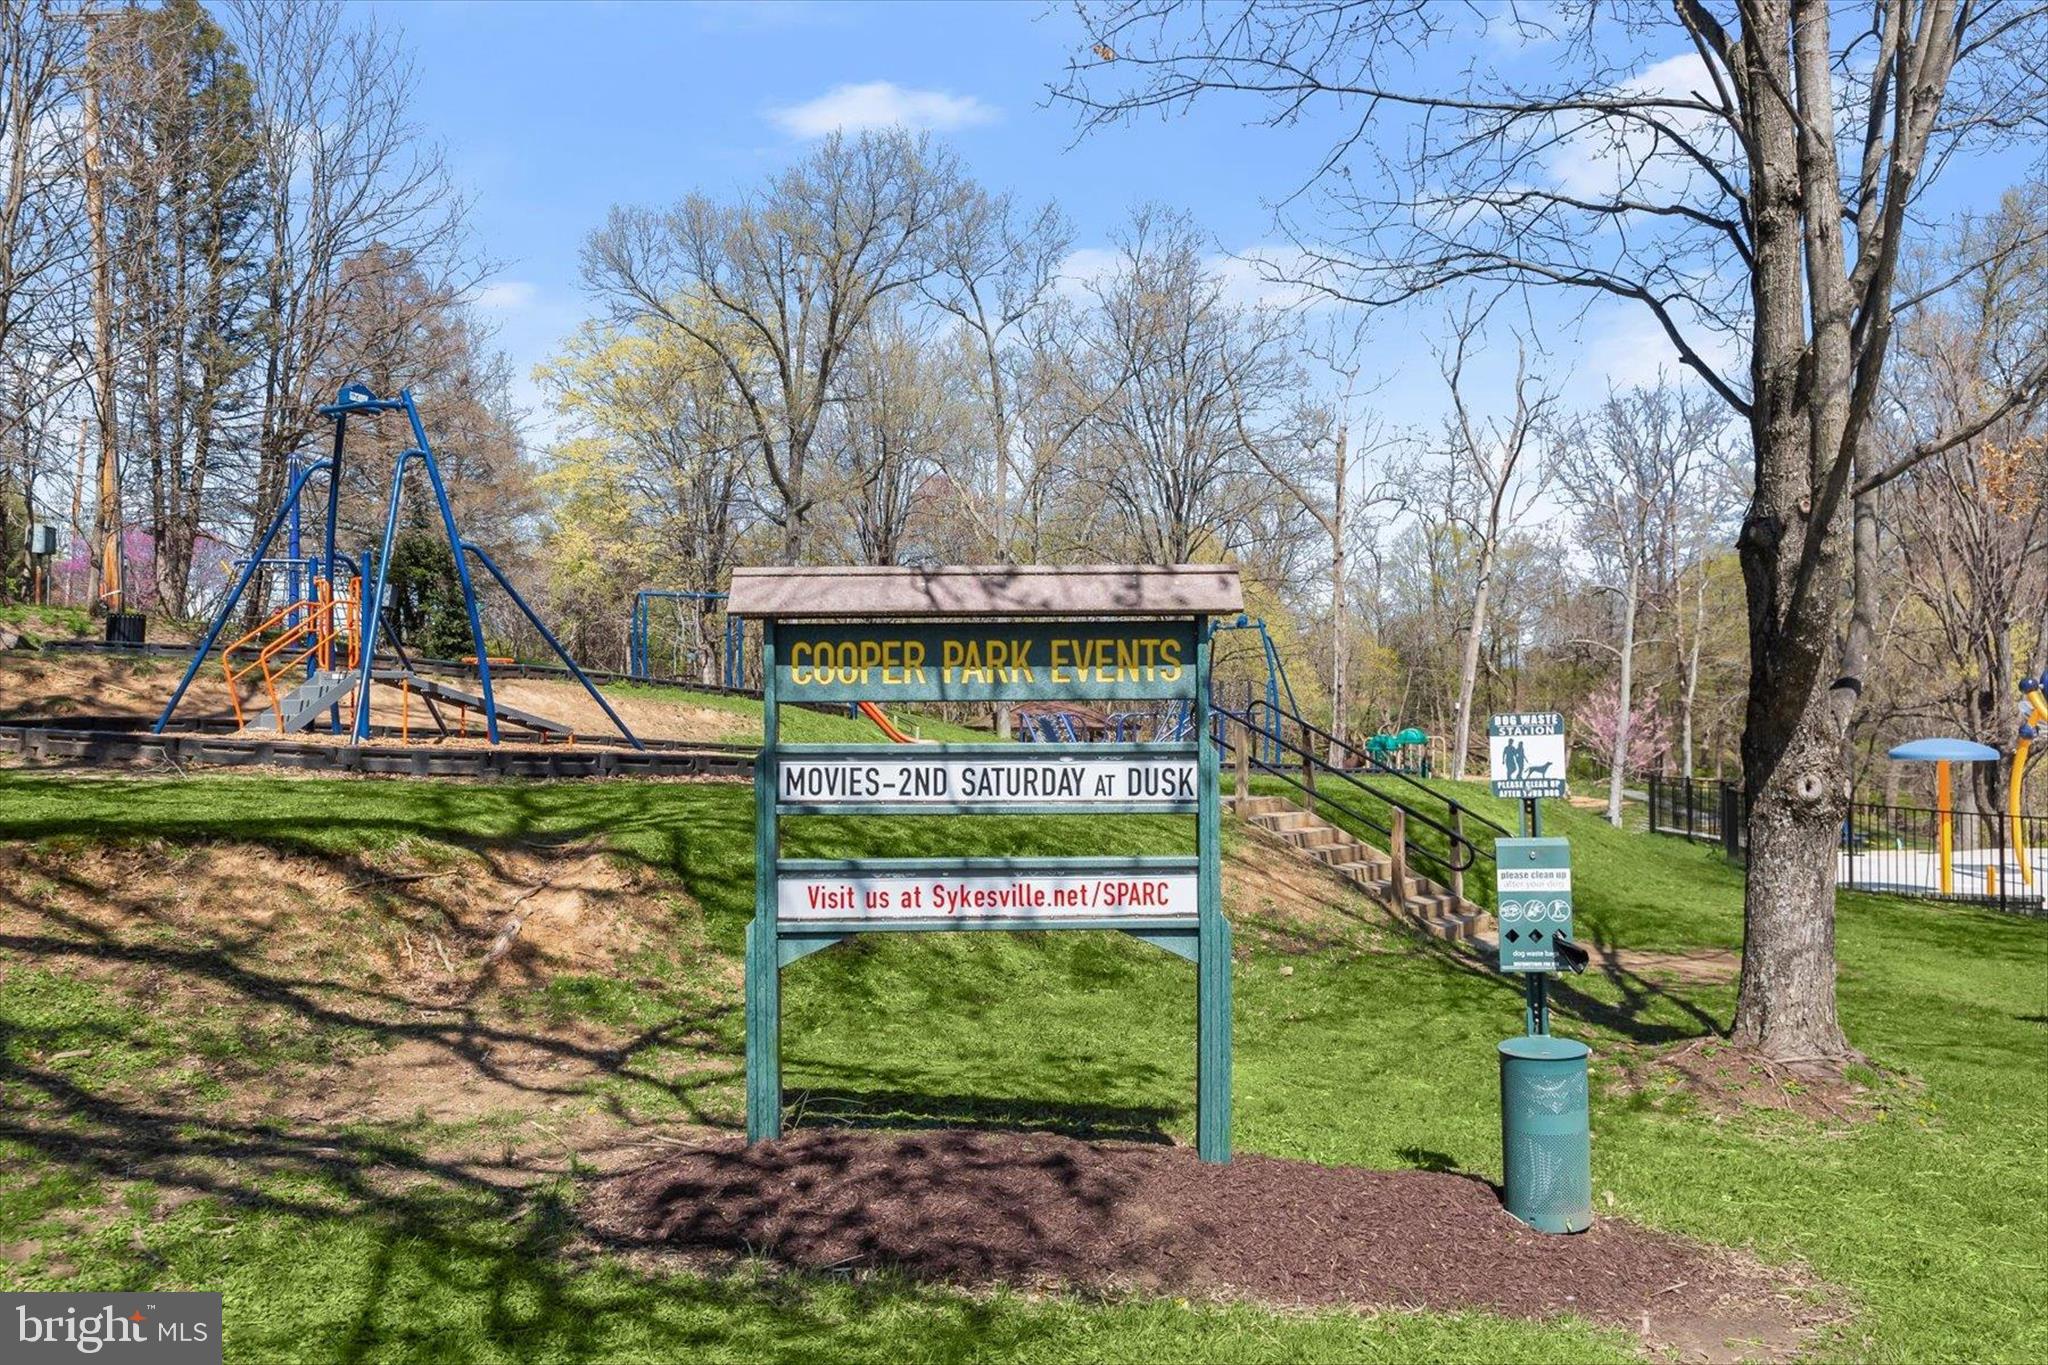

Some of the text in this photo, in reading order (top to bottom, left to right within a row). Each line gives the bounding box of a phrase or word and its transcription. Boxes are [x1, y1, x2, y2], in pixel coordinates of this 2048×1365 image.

[790, 638, 1182, 685] COOPER PARK EVENTS
[1520, 714, 1558, 725] WASTE
[785, 767, 1195, 797] MOVIES-2ND SATURDAY AT DUSK
[1501, 870, 1567, 880] please clean up
[808, 881, 1169, 914] Visit us at Sykesville.net/SPARC
